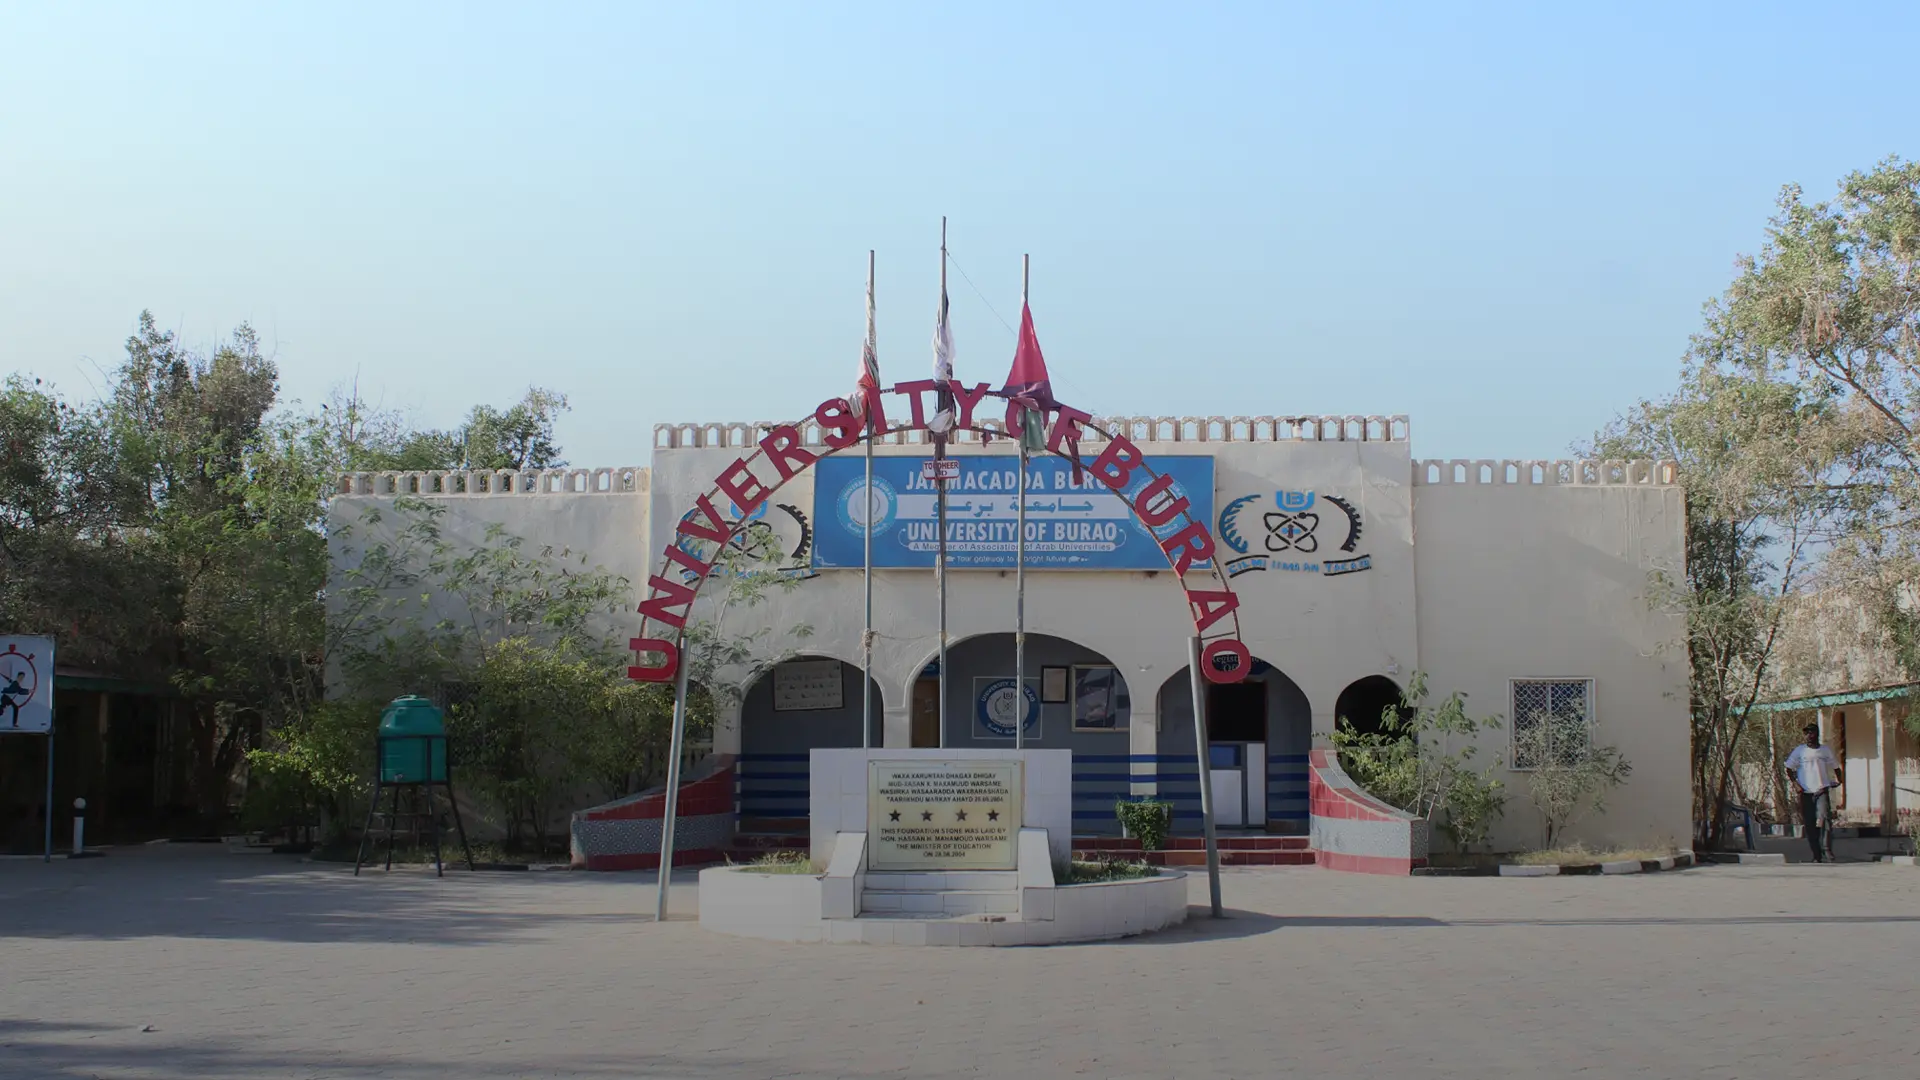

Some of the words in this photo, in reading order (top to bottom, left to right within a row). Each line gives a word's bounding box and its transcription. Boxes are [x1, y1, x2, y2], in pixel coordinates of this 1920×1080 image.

[627, 379, 991, 682] UNIVERSITY
[1088, 433, 1251, 684] BURAO
[907, 522, 1017, 541] UNIVERSITY
[1024, 522, 1047, 541] OF
[1054, 522, 1118, 541] BURAO
[969, 543, 1019, 551] Associatio
[1058, 543, 1112, 551] Universities
